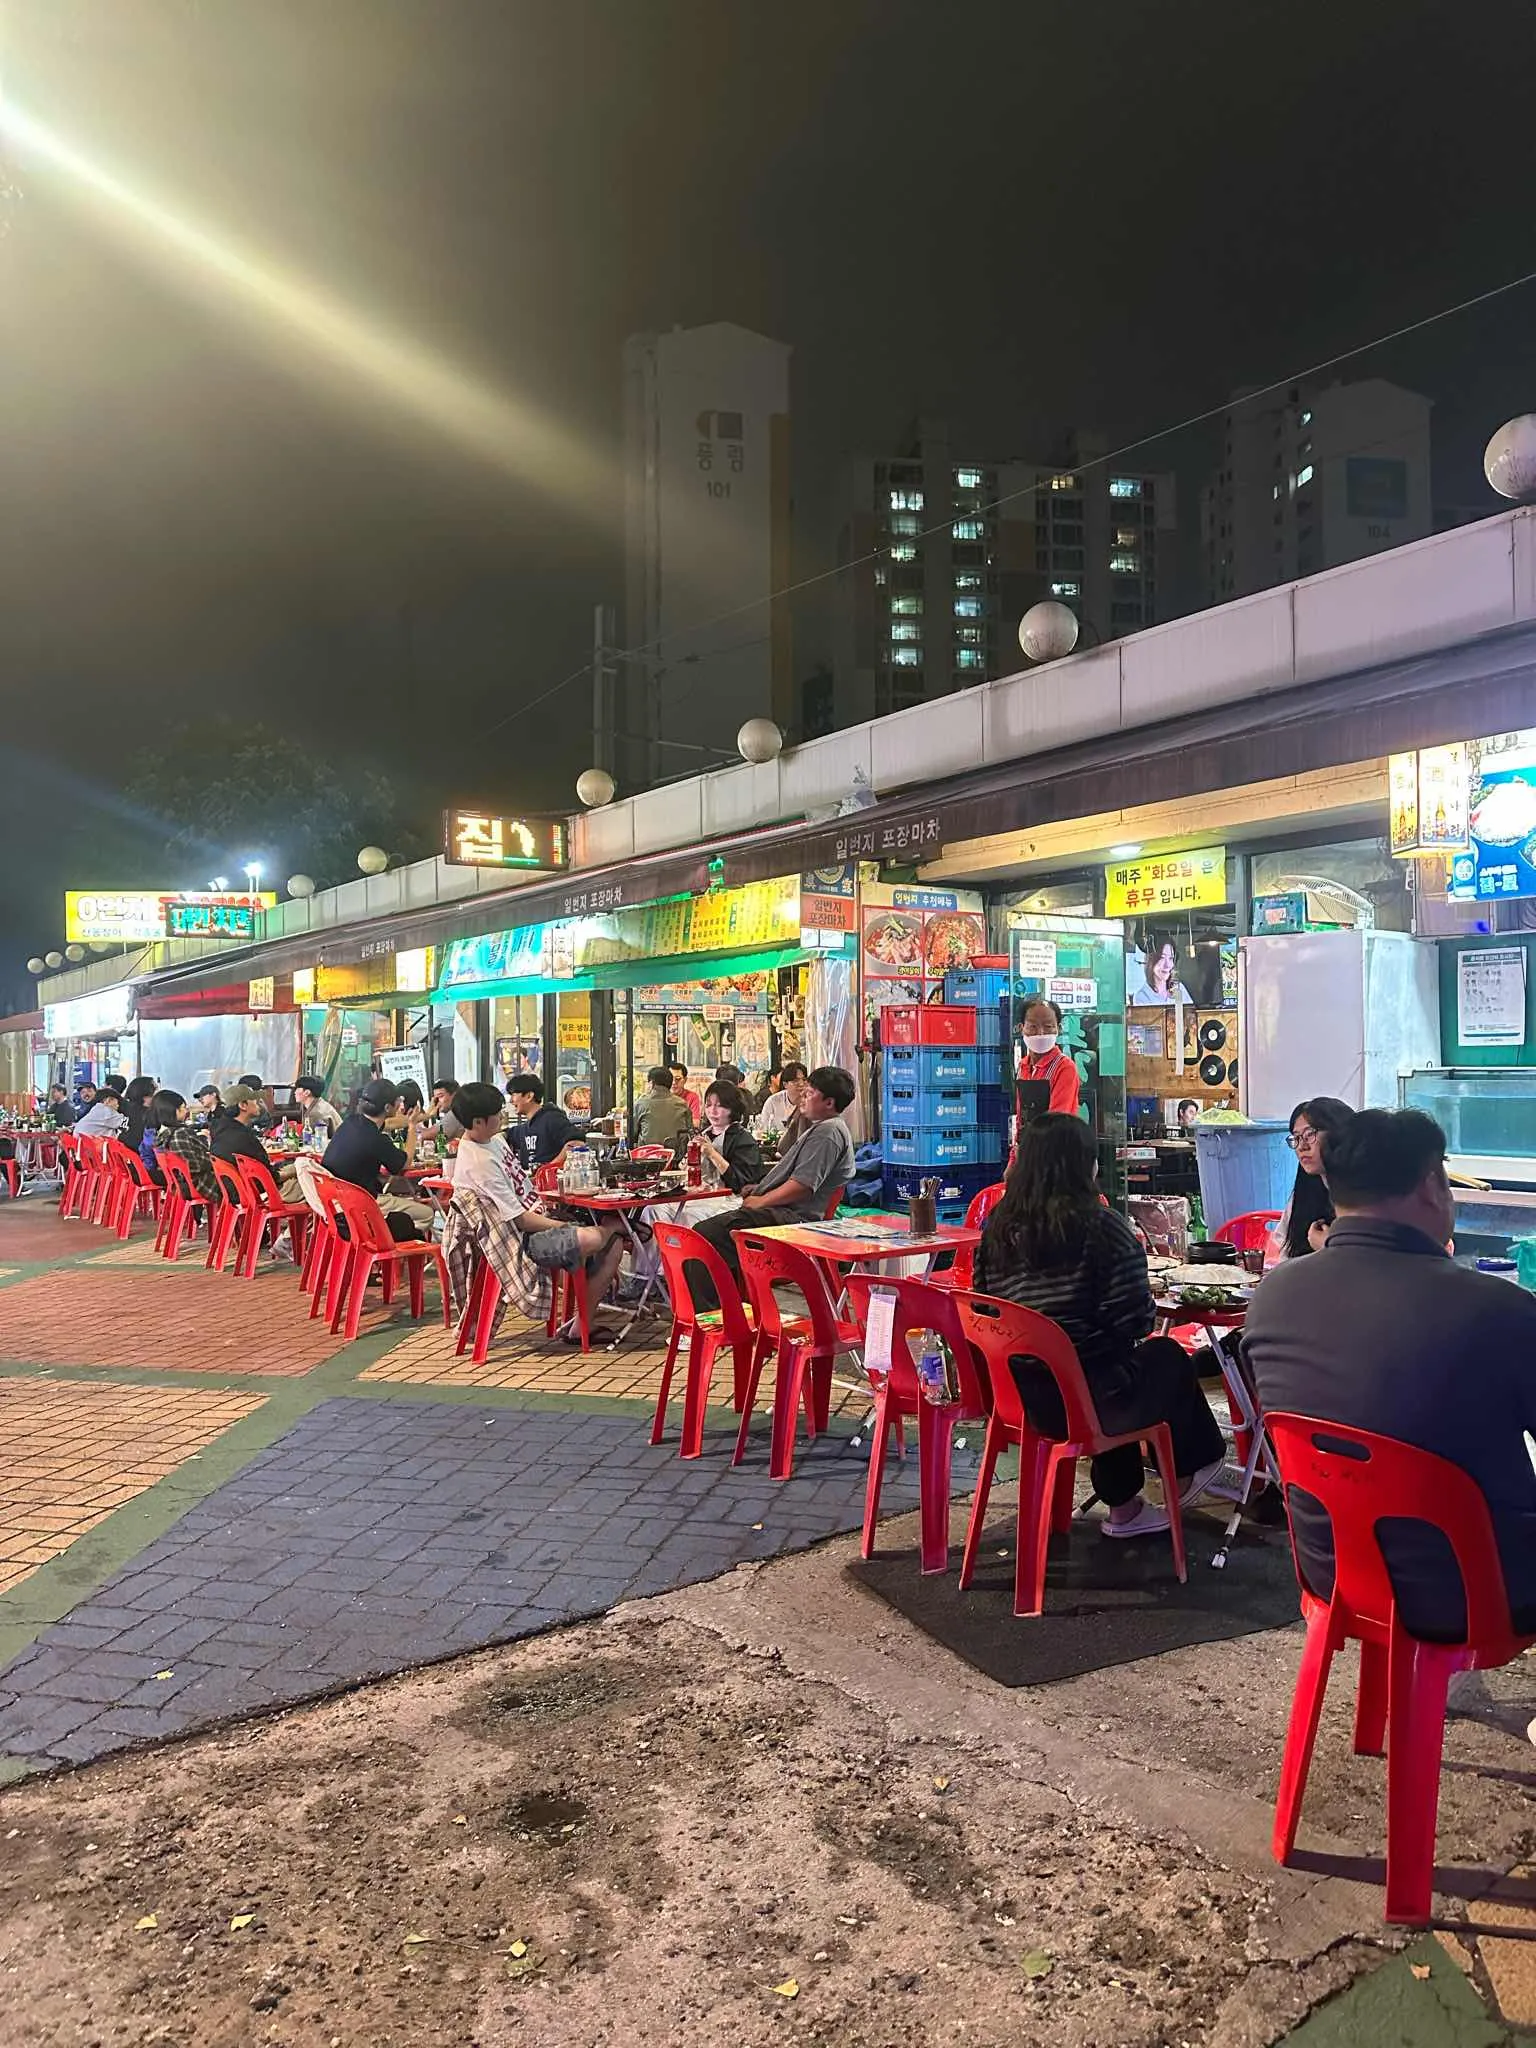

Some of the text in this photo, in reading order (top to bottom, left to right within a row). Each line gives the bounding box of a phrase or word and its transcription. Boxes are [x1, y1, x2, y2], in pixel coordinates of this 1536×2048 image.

[706, 481, 731, 499] 101
[836, 817, 941, 860] 일번지 포장마차
[1116, 869, 1142, 886] 매주
[1201, 860, 1213, 875] 은
[564, 885, 623, 914] 일번지 포장마차
[815, 899, 842, 913] 일번지
[1125, 884, 1201, 908] 휴무 입니다.
[808, 912, 847, 928] 포장마차
